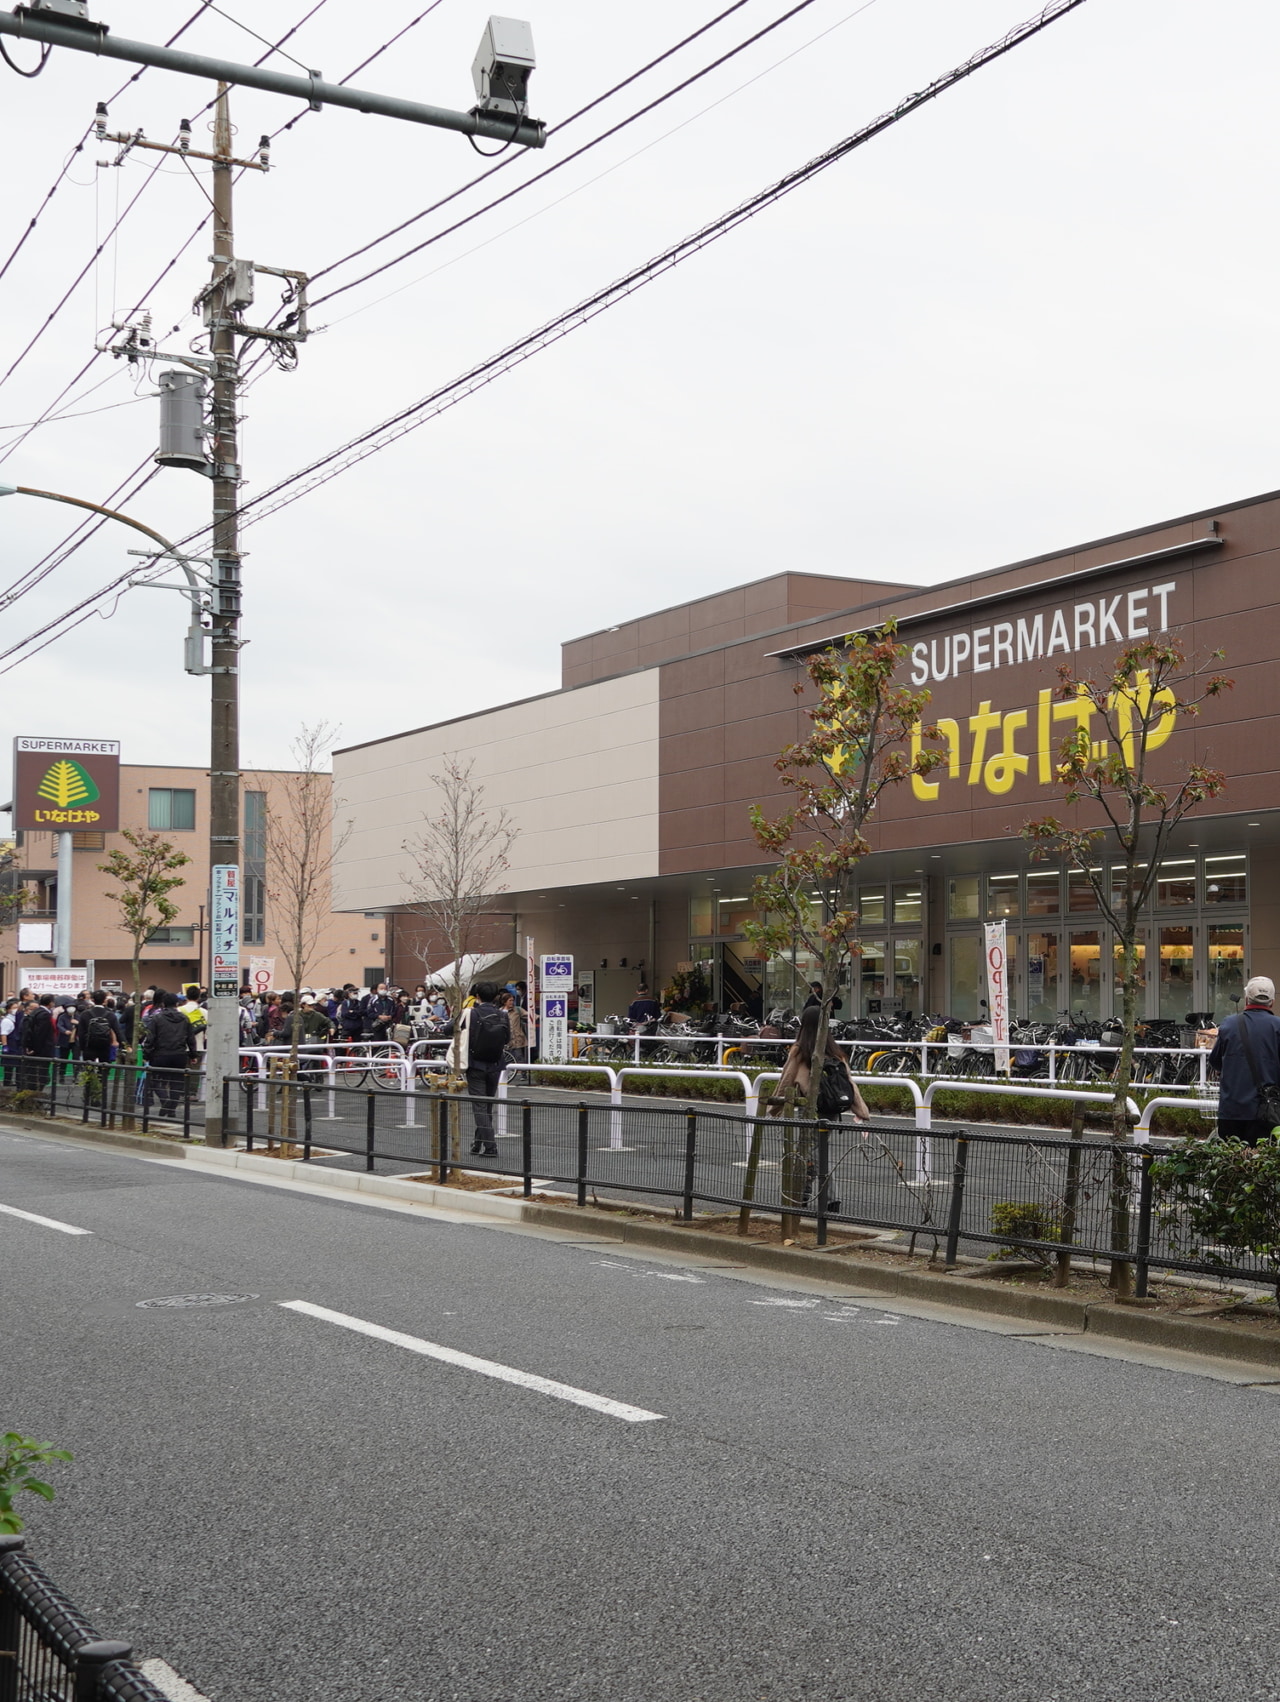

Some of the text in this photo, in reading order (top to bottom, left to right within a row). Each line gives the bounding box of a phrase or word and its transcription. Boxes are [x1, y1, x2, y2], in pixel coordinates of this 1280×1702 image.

[911, 581, 1176, 687] SUPERMARKET
[21, 740, 116, 753] SUPERMARKET
[222, 891, 235, 950] マルイチ
